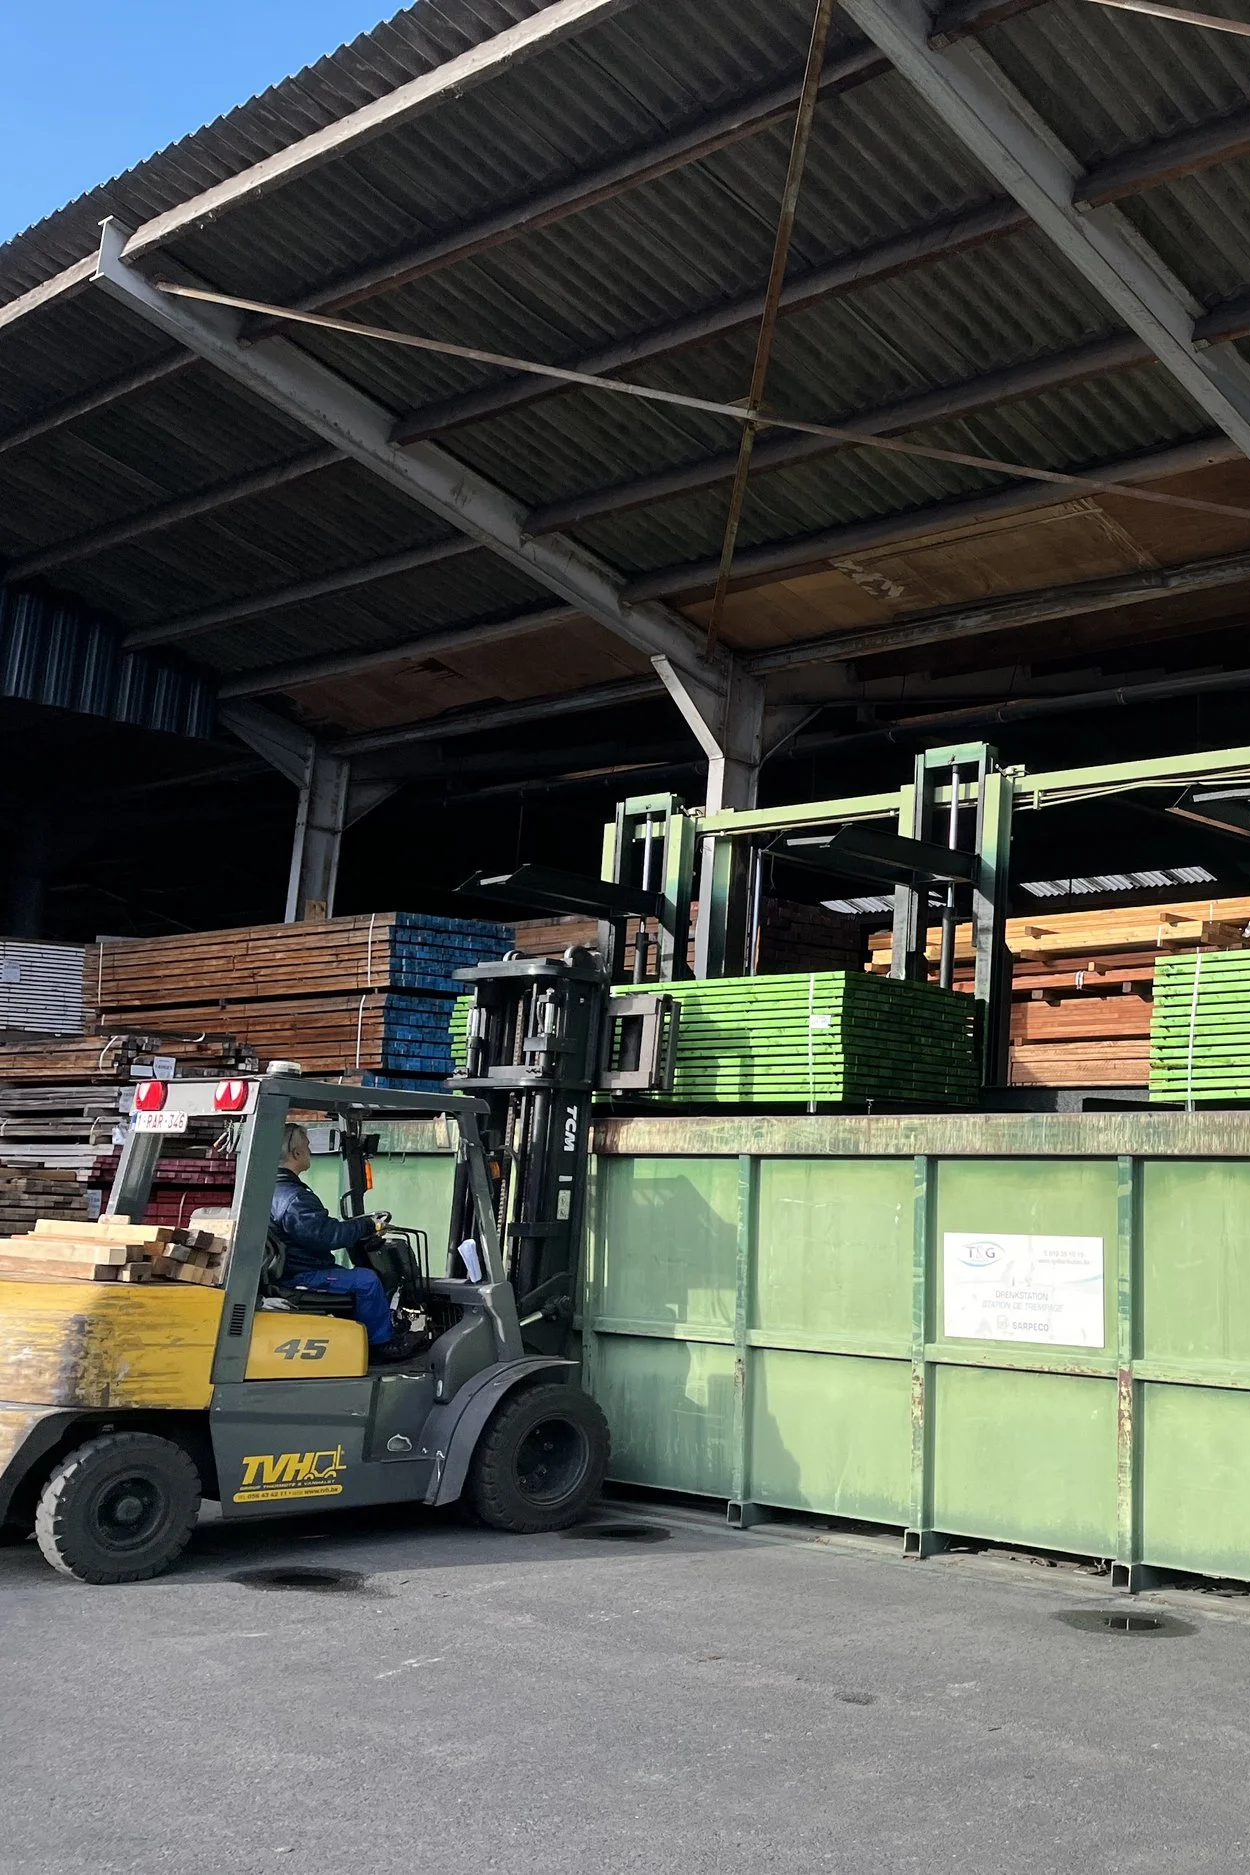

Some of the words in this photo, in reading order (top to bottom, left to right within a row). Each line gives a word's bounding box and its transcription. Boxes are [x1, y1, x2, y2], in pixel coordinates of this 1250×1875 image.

[138, 1113, 185, 1129] 1-RAR-346
[564, 1105, 578, 1152] TCM
[1011, 1321, 1049, 1332] SARPECO
[274, 1339, 330, 1360] 45
[242, 1452, 315, 1485] TVH
